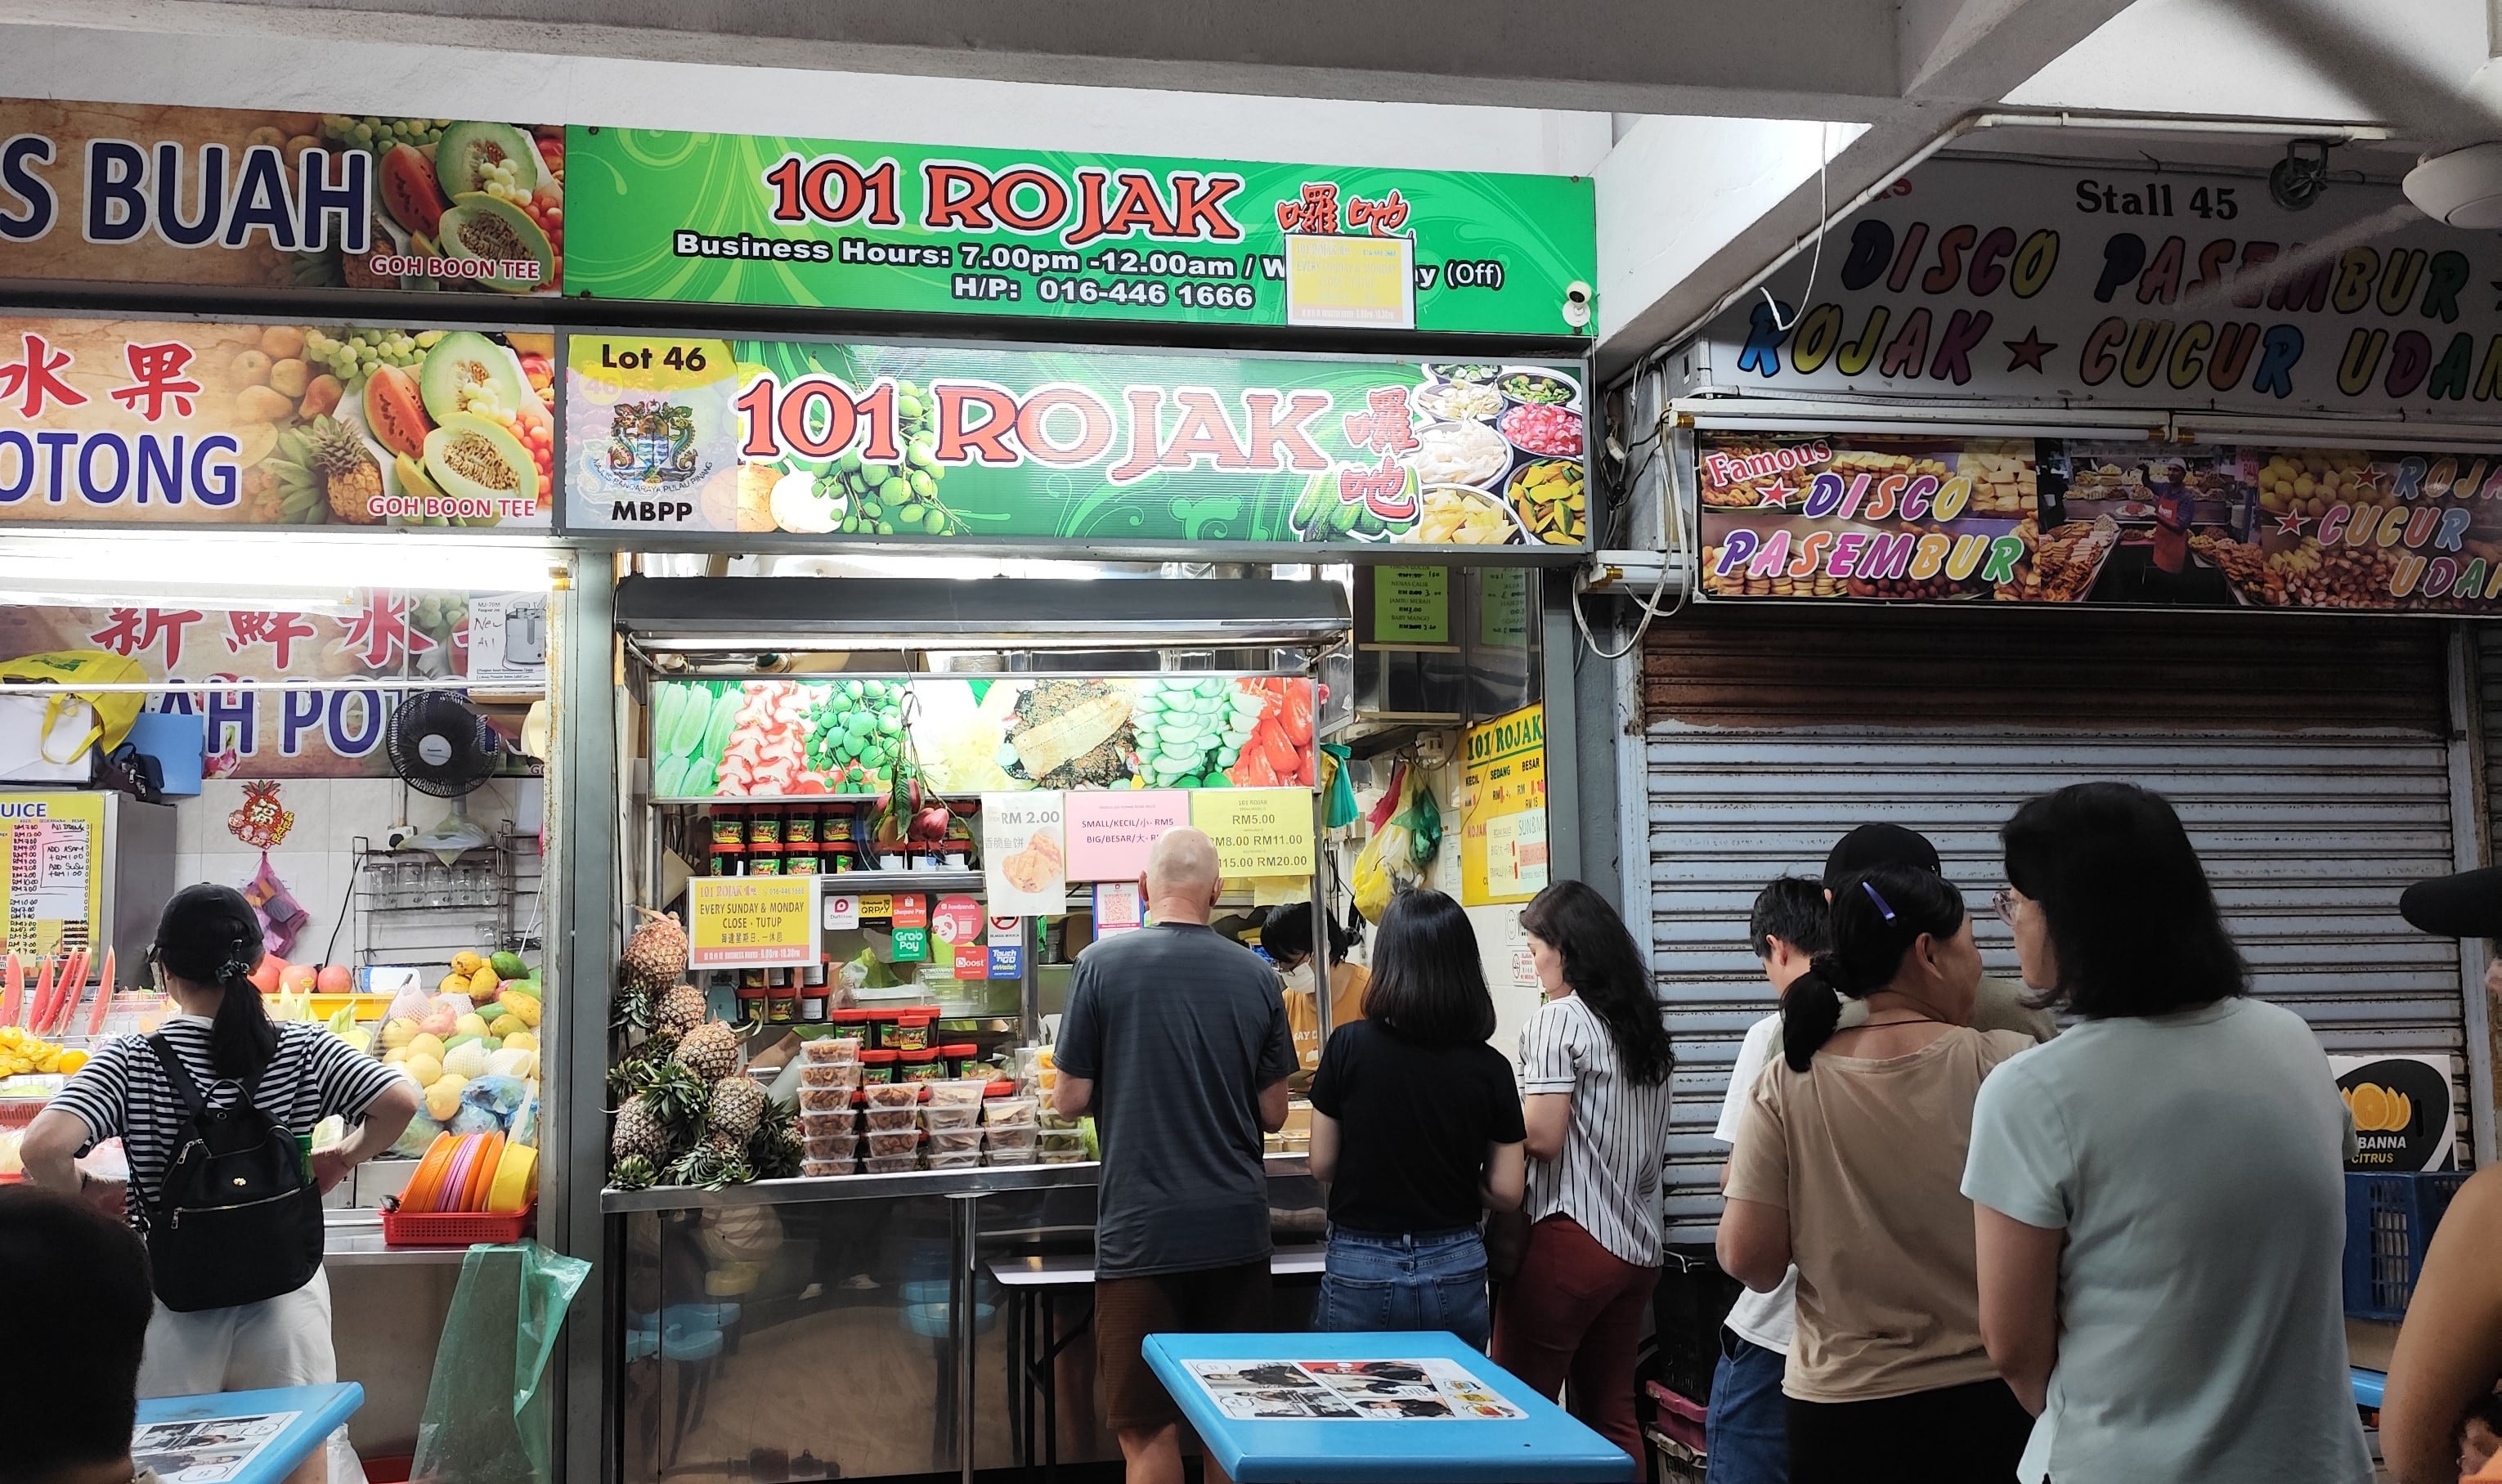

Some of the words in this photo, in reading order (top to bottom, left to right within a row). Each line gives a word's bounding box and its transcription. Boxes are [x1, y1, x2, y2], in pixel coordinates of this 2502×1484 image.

[0, 137, 51, 240] S
[88, 142, 367, 249] BUAH
[767, 158, 899, 224] 101
[925, 164, 1240, 244] ROJAK
[2076, 179, 2173, 217] Stall
[2189, 186, 2239, 220] 45
[370, 256, 422, 276] GOH
[428, 258, 495, 278] BOON
[501, 260, 540, 280] TEE
[676, 233, 830, 261] Business
[843, 240, 950, 266] Hours:
[962, 246, 1079, 272] 7.00pm
[1446, 262, 1504, 287] (Off)
[1841, 219, 2060, 299] DISCO
[2093, 232, 2470, 324] PASEMBUR
[953, 277, 1019, 299] H/P:
[1039, 280, 1166, 304] 016-446
[1179, 285, 1253, 307] 1666
[602, 344, 653, 370] Lot
[663, 346, 706, 371] 46
[1738, 300, 1993, 385] ROJAK
[2079, 316, 2304, 398] CUCUR
[0, 334, 202, 422] 水果
[738, 379, 899, 460] 101
[935, 384, 1329, 482] ROJAK
[593, 459, 613, 482] MAJLIS
[613, 477, 661, 493] BANDARAYA
[663, 482, 690, 492] PULAU
[691, 460, 713, 484] PINANG
[1706, 438, 1832, 487] Famous
[370, 497, 420, 515] GOH
[425, 499, 492, 517] BOON
[498, 500, 536, 518] TEE
[612, 500, 693, 522] MBPP
[1803, 473, 1972, 522] DISCO
[2317, 504, 2470, 552] CUCUR
[1716, 528, 2024, 584] PASEMBUR
[91, 590, 468, 670] 新鮮水
[1468, 732, 1491, 760] 101
[1496, 715, 1544, 752] ROJAK
[1466, 774, 1480, 787] KECIL
[1491, 765, 1511, 780] SEDANG
[1522, 757, 1540, 772] BESAR
[1, 803, 47, 818] UICE
[1001, 812, 1022, 824] RM
[1026, 810, 1060, 823] 2.00
[1232, 814, 1276, 825] RM5.00
[984, 836, 1025, 850] 香脆鱼饼
[1253, 835, 1303, 845] RM11.00
[1218, 858, 1253, 868] 15.00
[1258, 855, 1307, 867] RM20.00
[700, 886, 714, 898] 101
[716, 885, 742, 897] ROJAK
[700, 903, 725, 915] EVERY
[727, 903, 759, 914] SUNDAY
[760, 904, 766, 913] &
[770, 902, 805, 913] MONDAY
[723, 917, 747, 929] CLOSE
[756, 917, 782, 928] TUTUP
[895, 930, 923, 941] Grab
[899, 942, 919, 952] Pay
[2351, 1153, 2394, 1164] CITRUS
